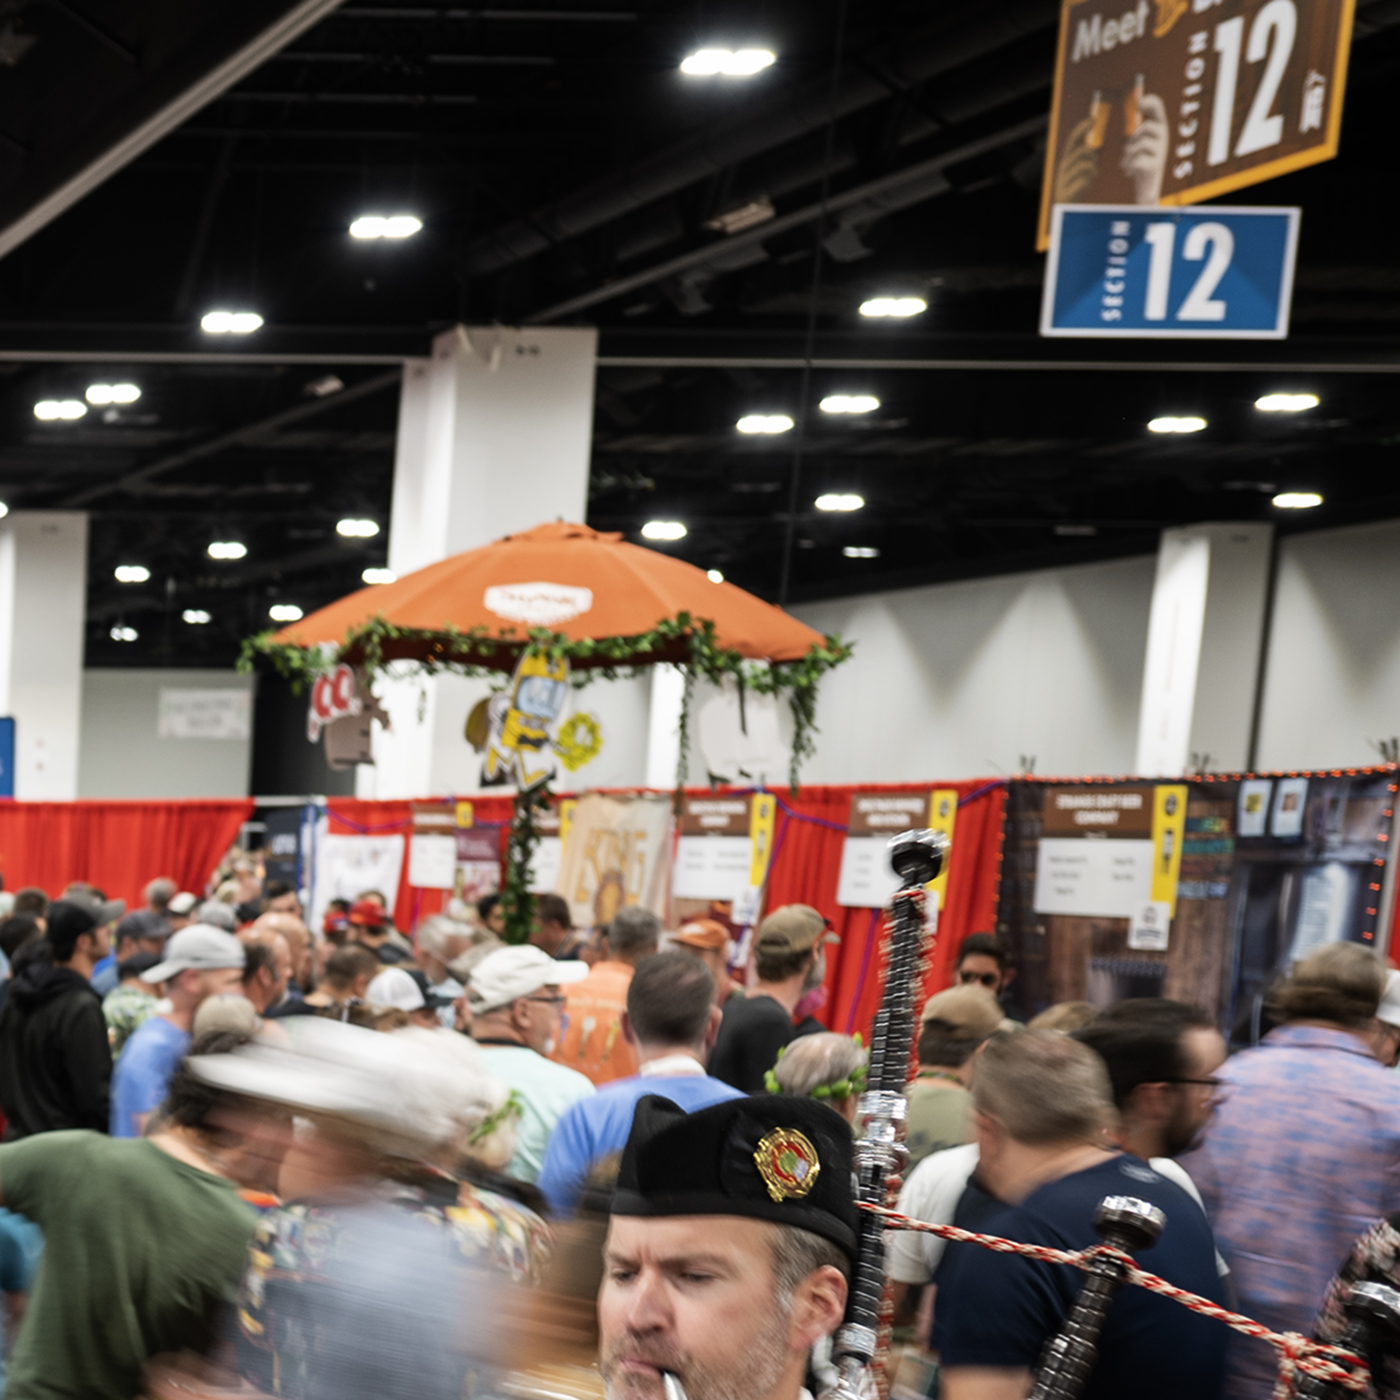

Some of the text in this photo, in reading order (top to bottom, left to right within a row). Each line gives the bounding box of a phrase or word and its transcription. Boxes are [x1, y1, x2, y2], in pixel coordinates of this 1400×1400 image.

[1070, 3, 1151, 63] Meet
[1173, 31, 1209, 179] SECTION
[1206, 0, 1298, 166] 12
[1101, 219, 1235, 322] SECTION 12
